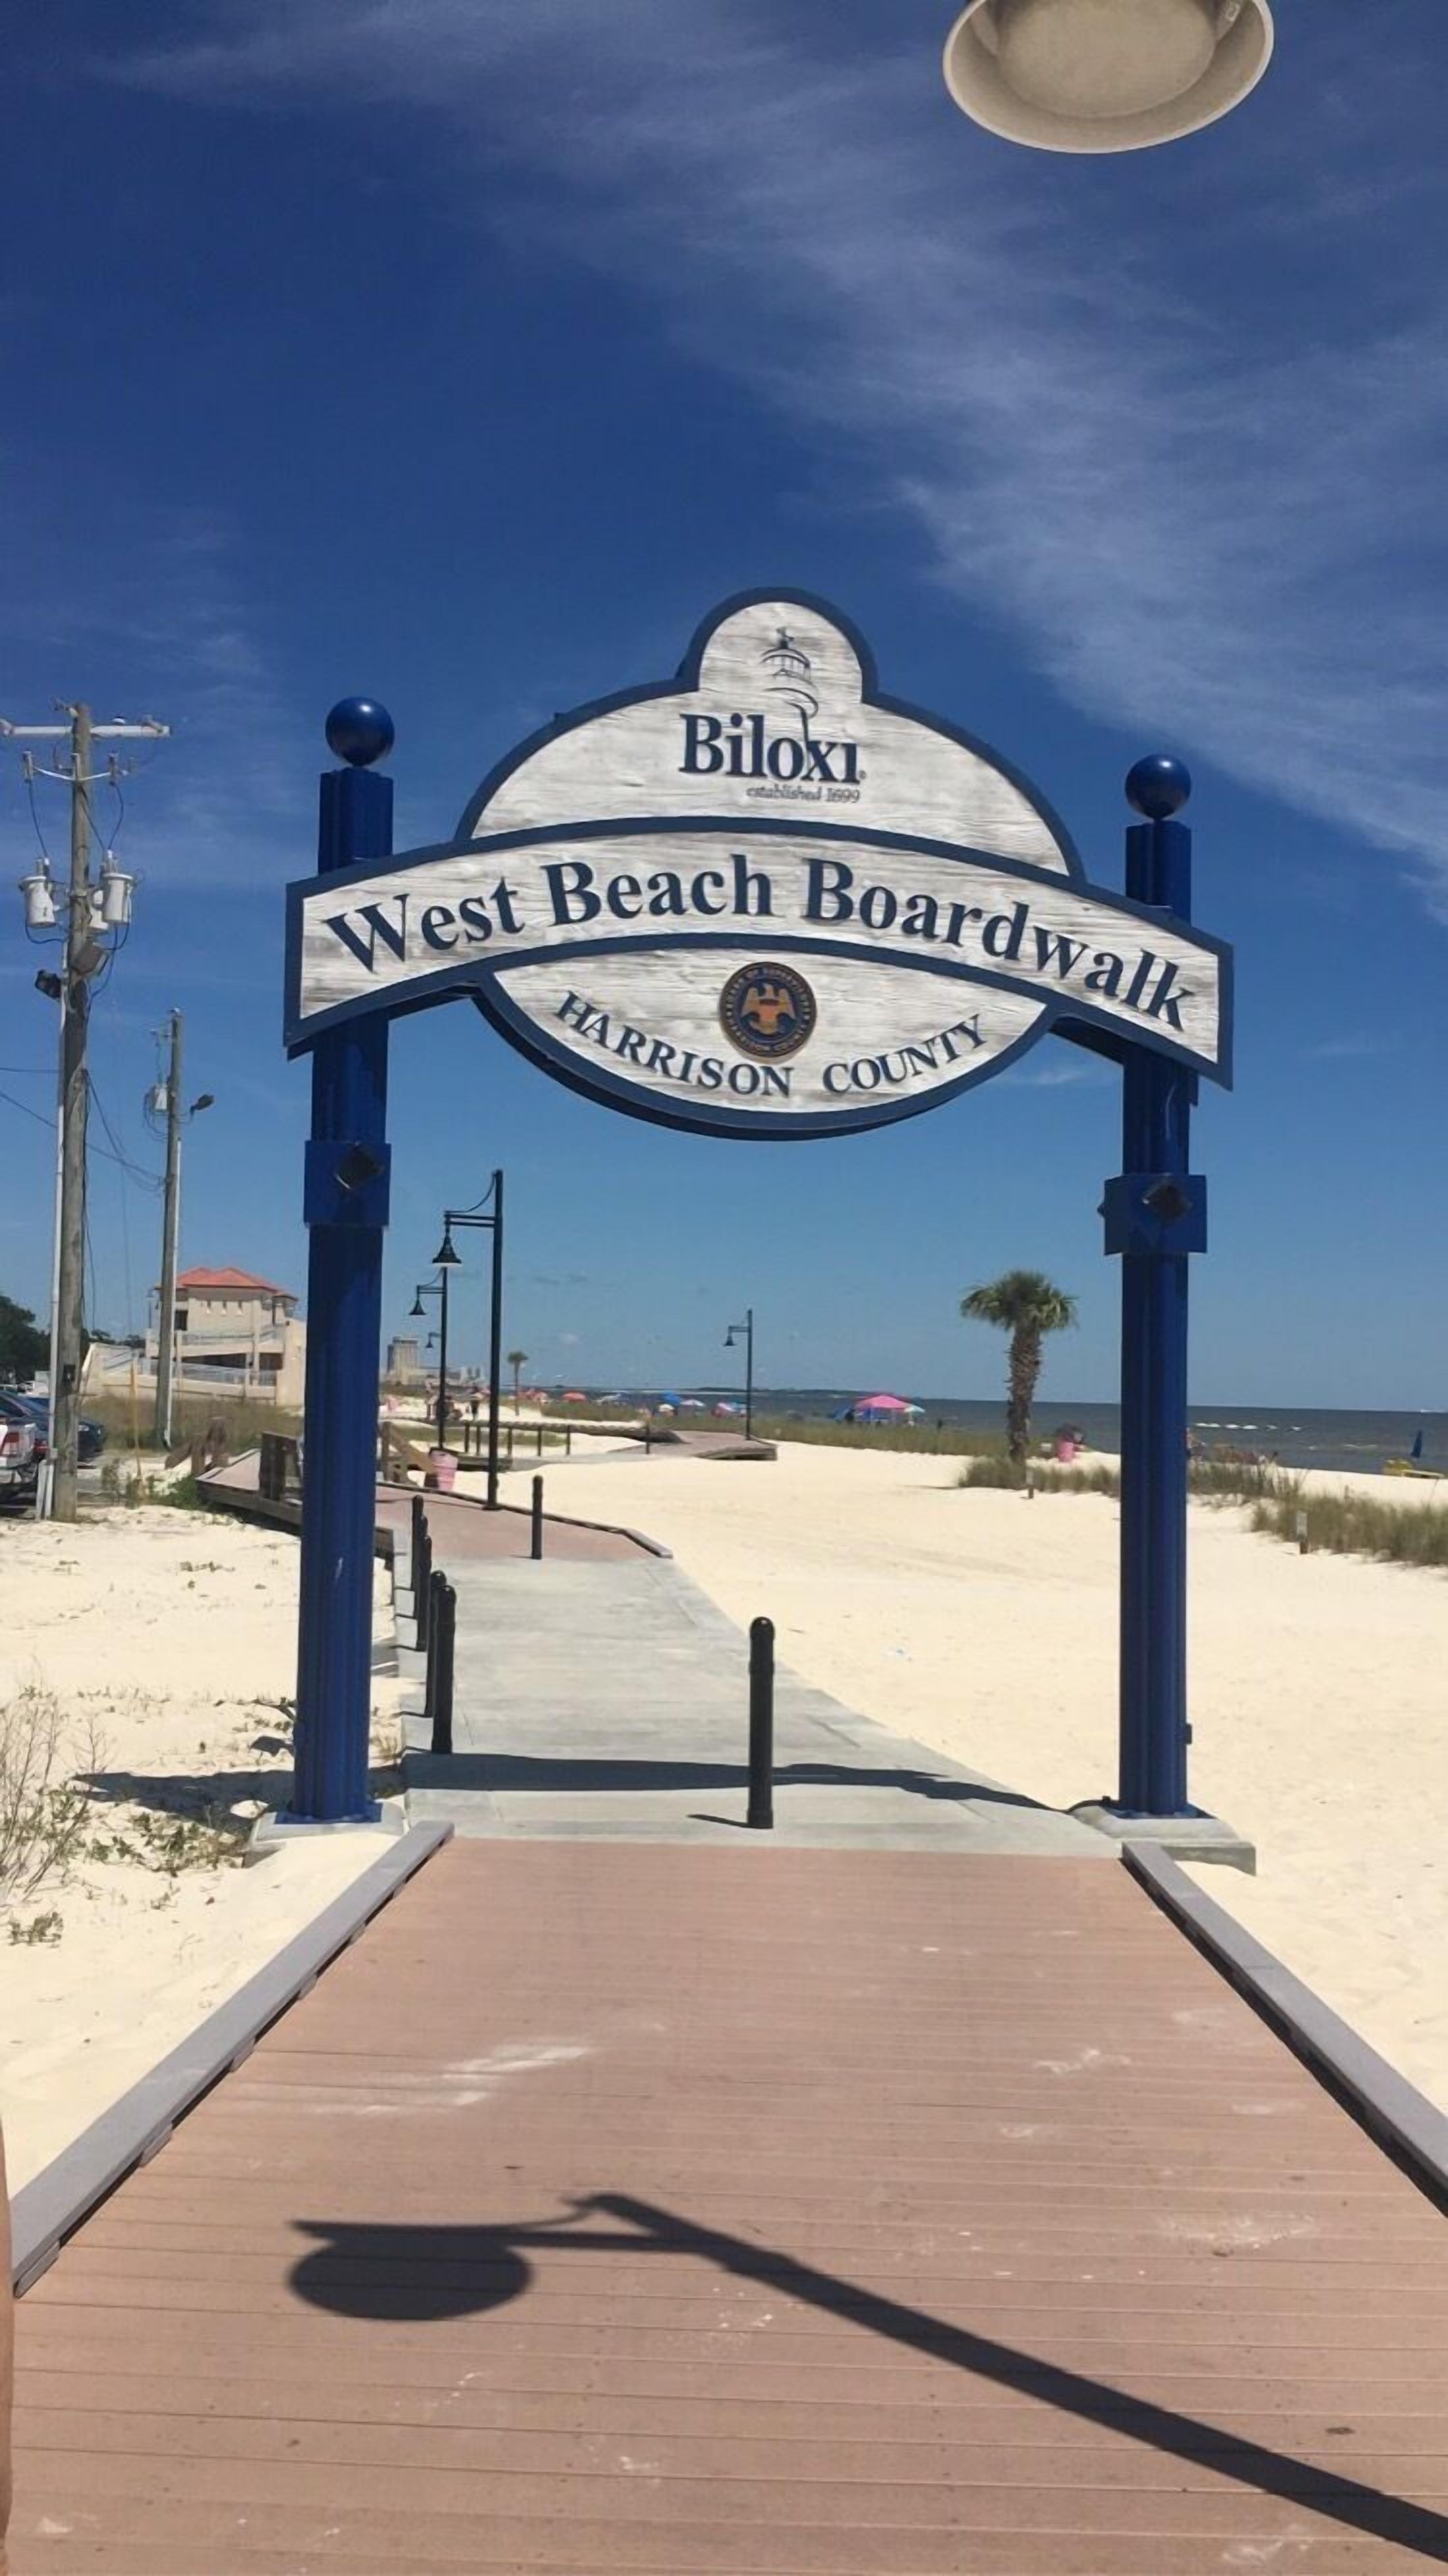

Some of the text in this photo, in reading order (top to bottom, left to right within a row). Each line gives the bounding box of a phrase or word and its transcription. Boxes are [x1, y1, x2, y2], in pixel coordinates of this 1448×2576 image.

[679, 712, 860, 784] Biloxi
[320, 877, 525, 973] West
[540, 854, 775, 926] Beach
[802, 857, 1194, 1032] Boardwalk
[553, 991, 794, 1097] HARRISON
[823, 1014, 988, 1096] COUNTY
